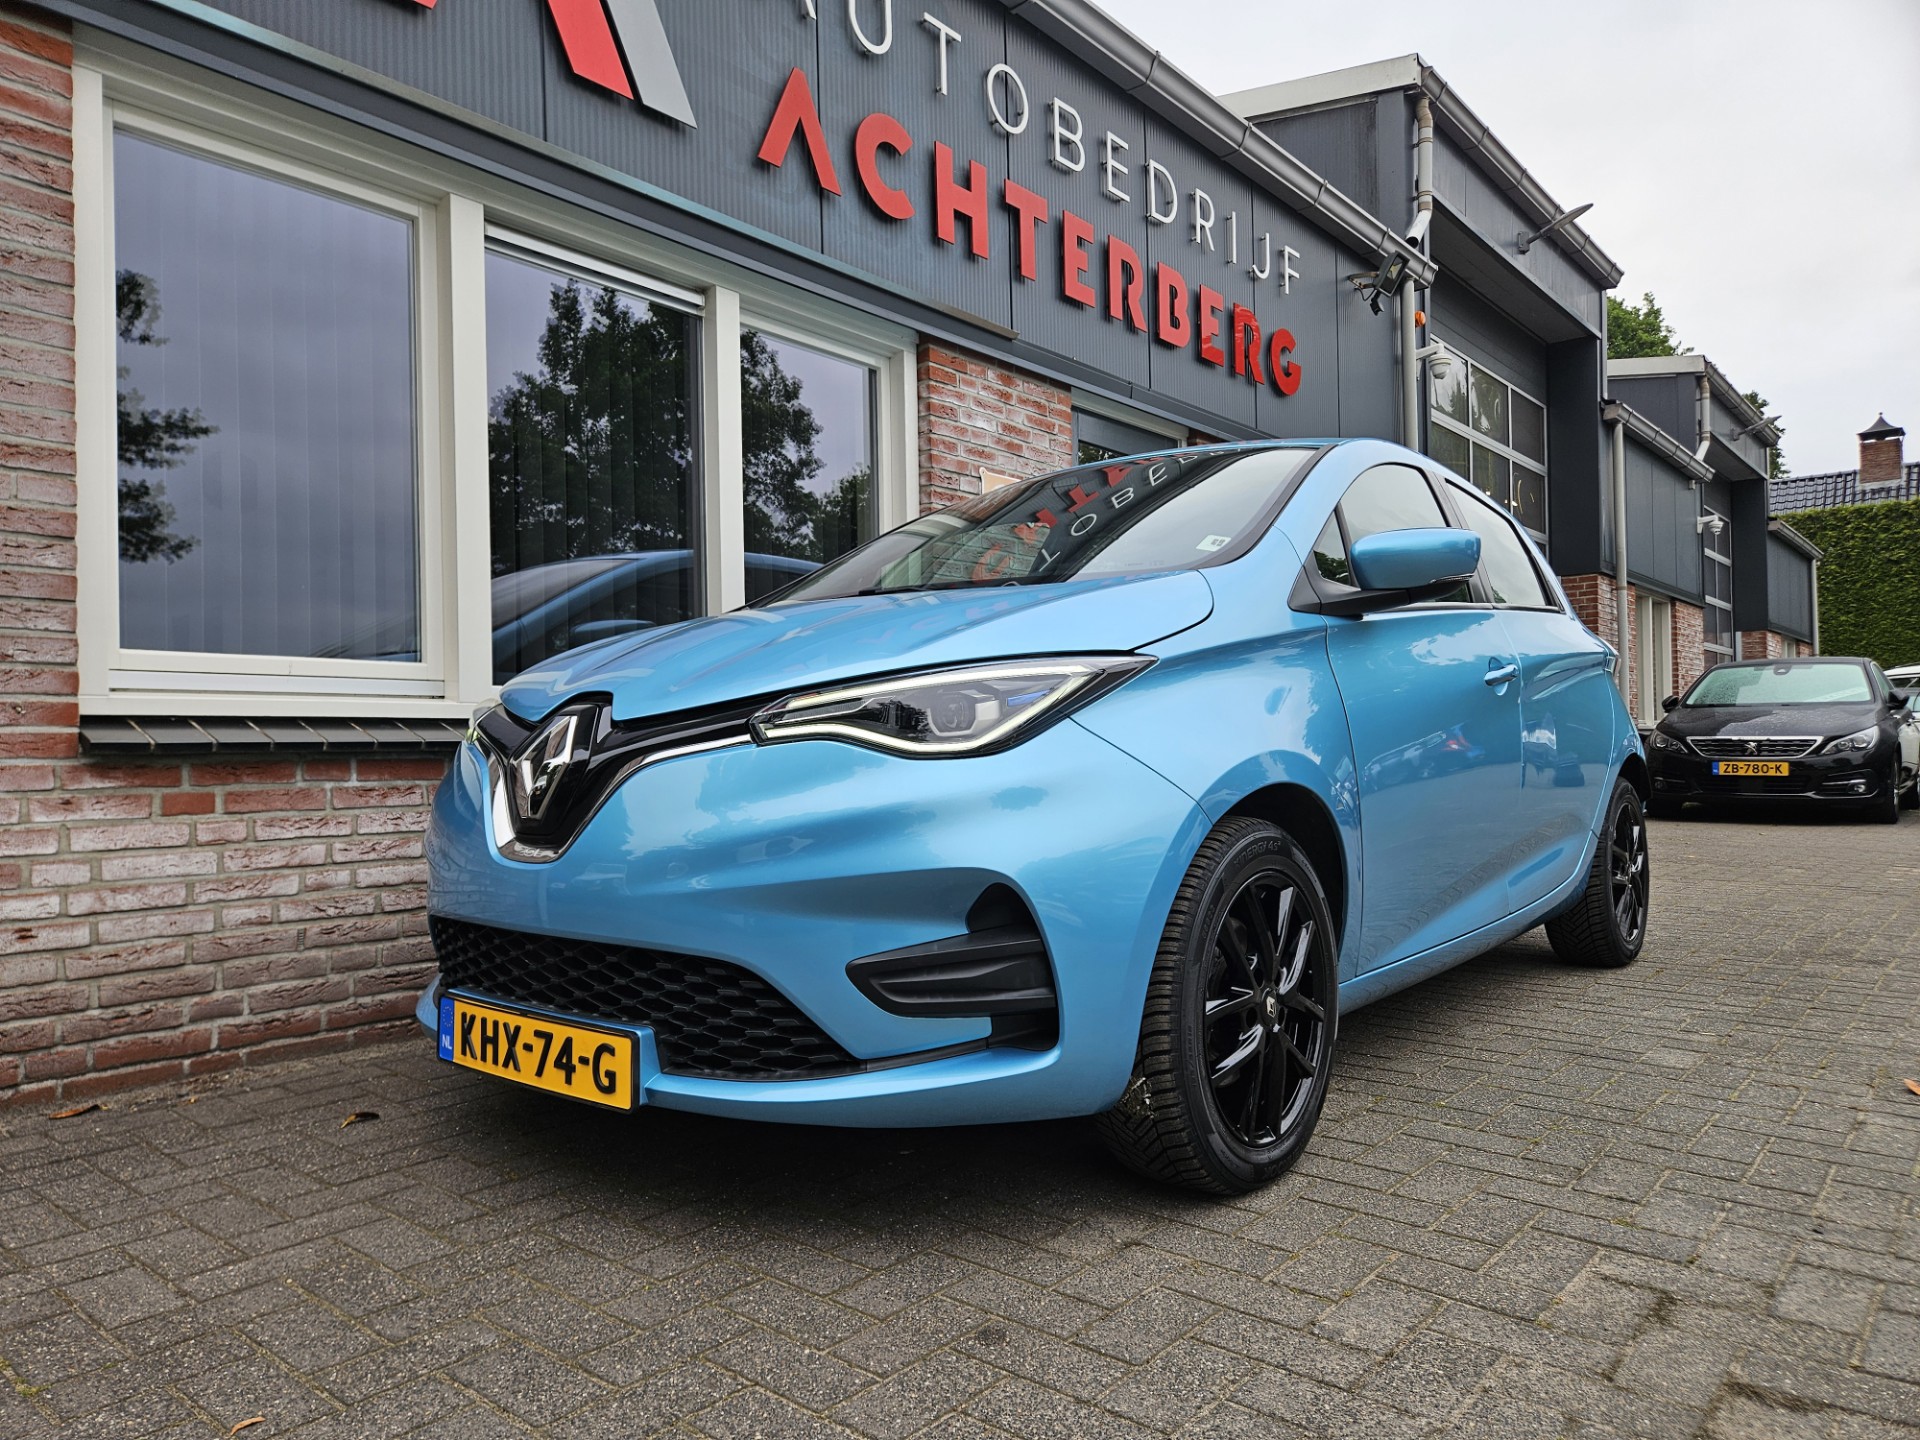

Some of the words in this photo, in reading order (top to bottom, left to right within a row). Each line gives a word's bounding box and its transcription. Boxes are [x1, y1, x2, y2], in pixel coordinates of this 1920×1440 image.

[804, 0, 1300, 294] UTOBEDRIJF
[758, 67, 1302, 396] ACHTERBERG
[1723, 763, 1783, 774] ZB-780-K
[442, 1034, 453, 1050] NL
[460, 1011, 617, 1095] KHX-74-G
